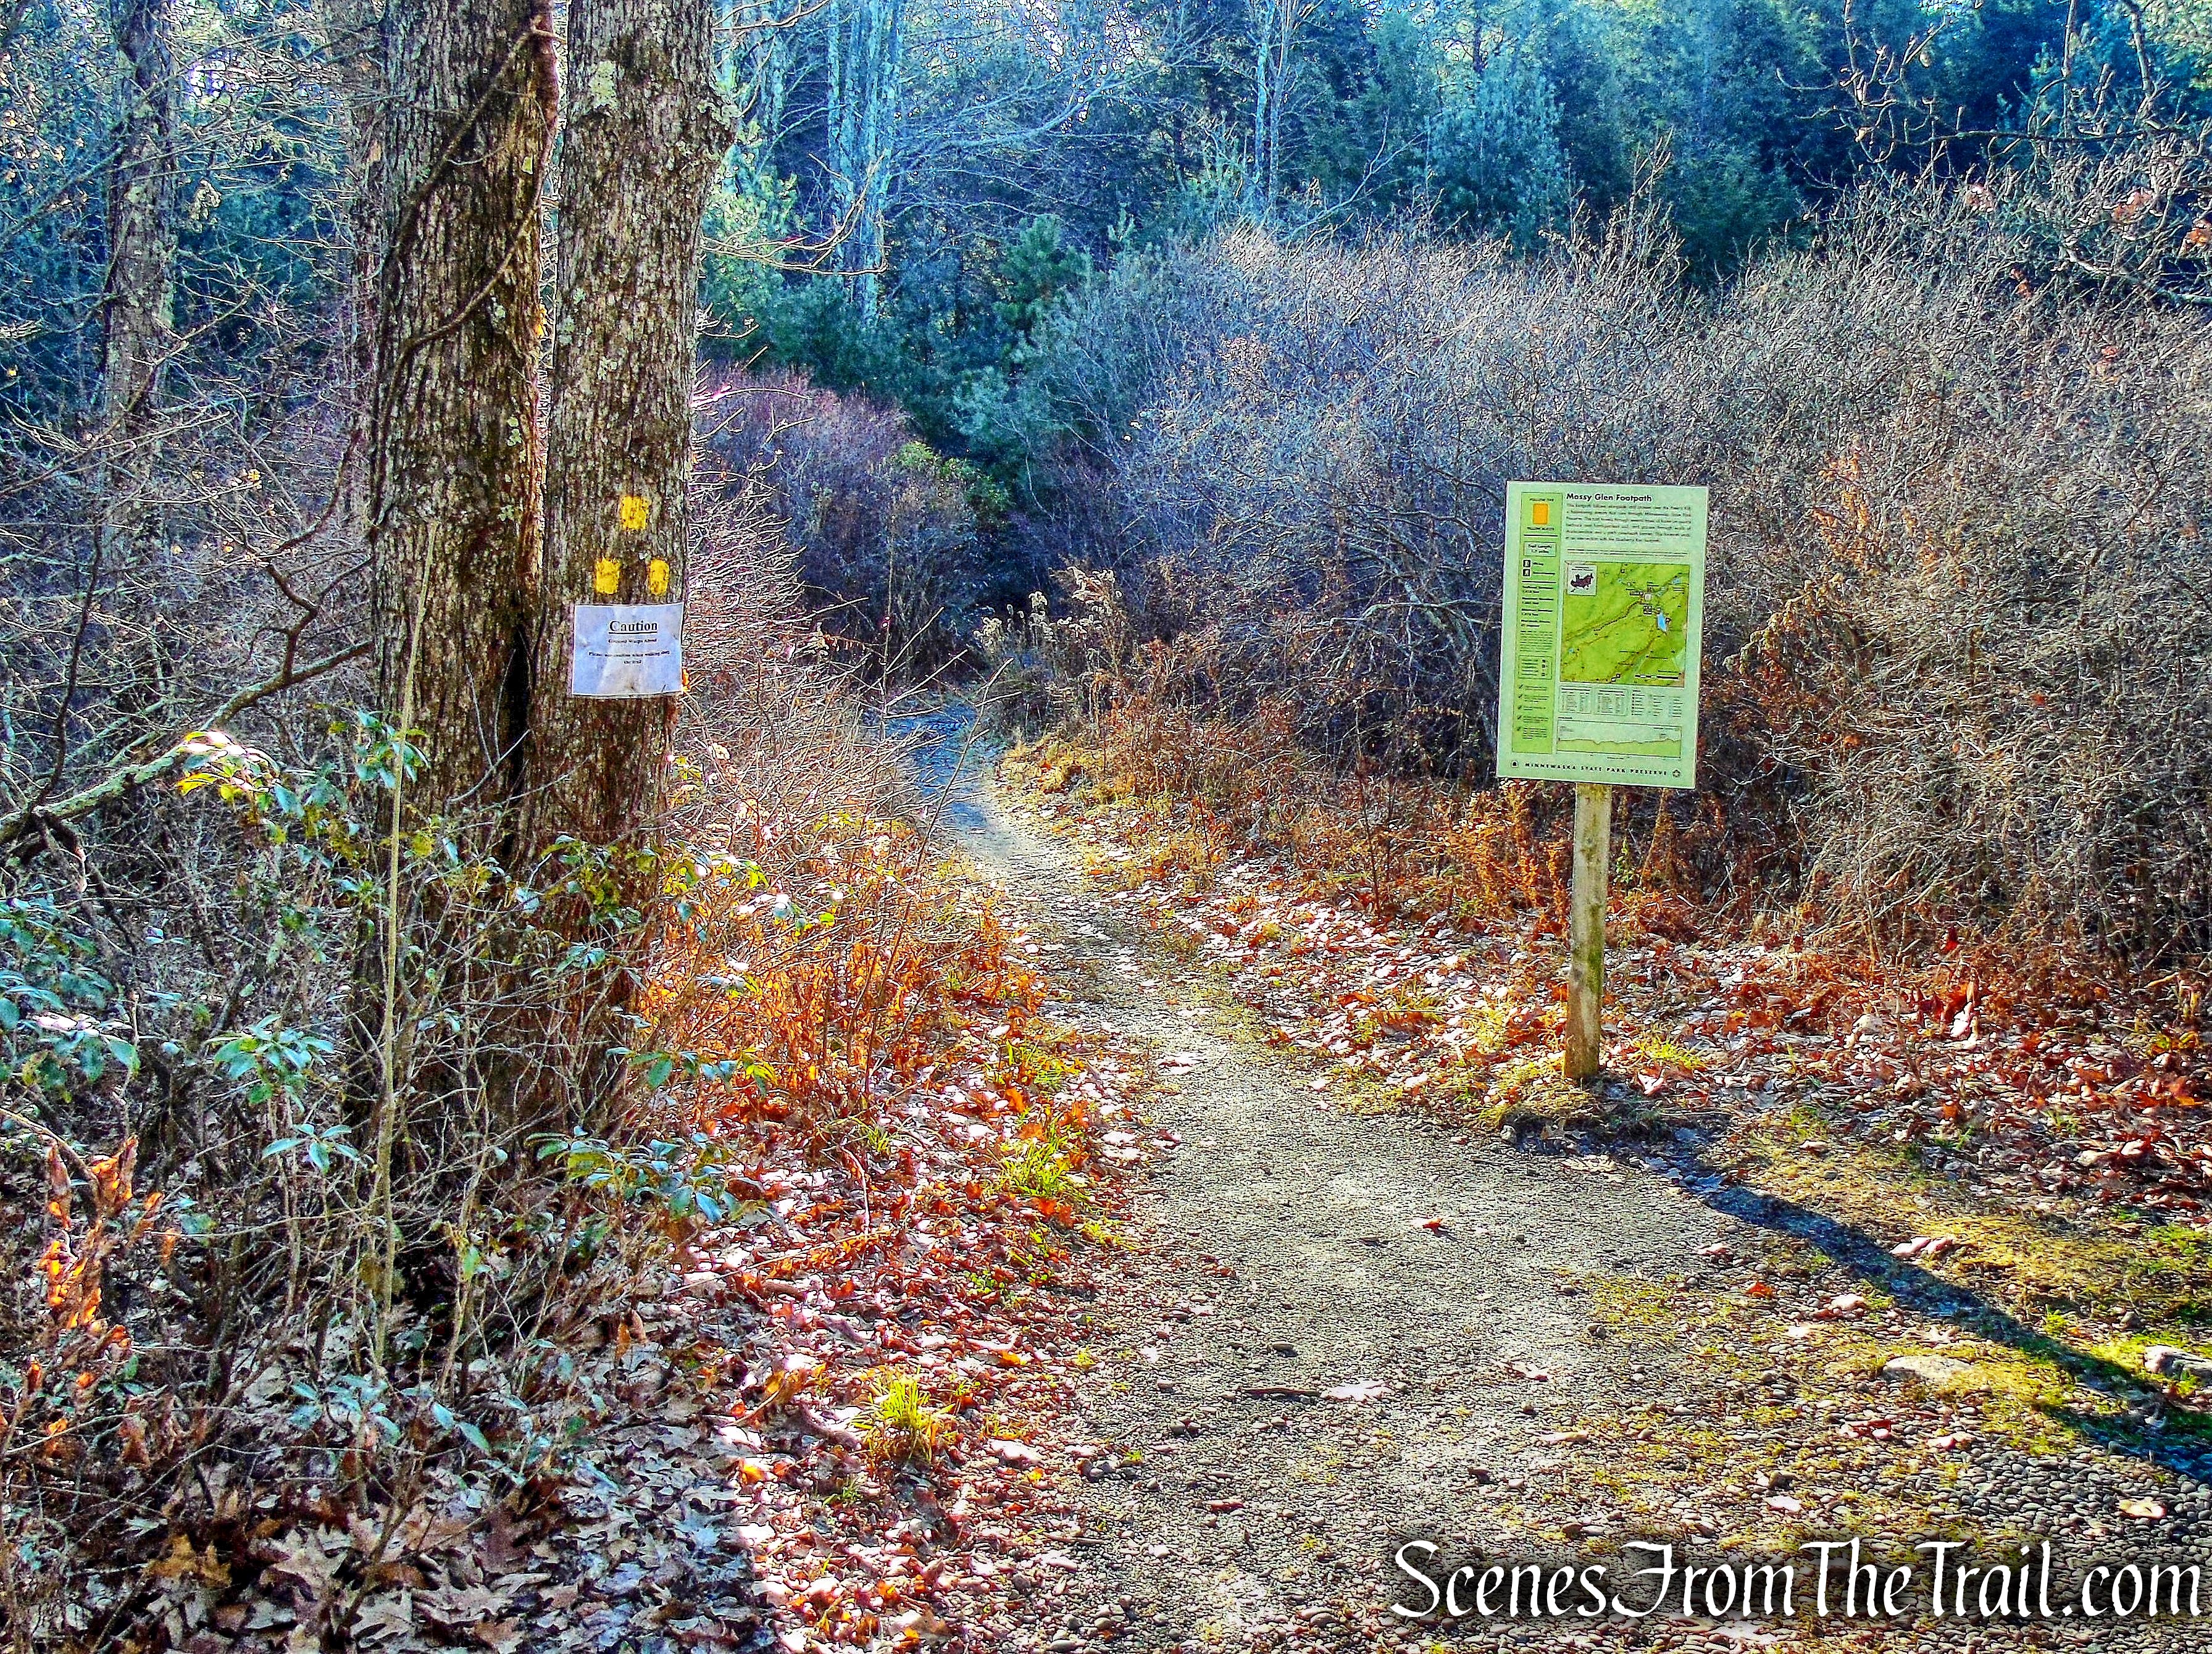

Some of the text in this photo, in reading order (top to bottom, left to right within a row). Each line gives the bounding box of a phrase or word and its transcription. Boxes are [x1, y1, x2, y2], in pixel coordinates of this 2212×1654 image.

[1566, 493, 1592, 501] Mossy
[1616, 495, 1651, 503] Footpath
[609, 620, 657, 632] Caution
